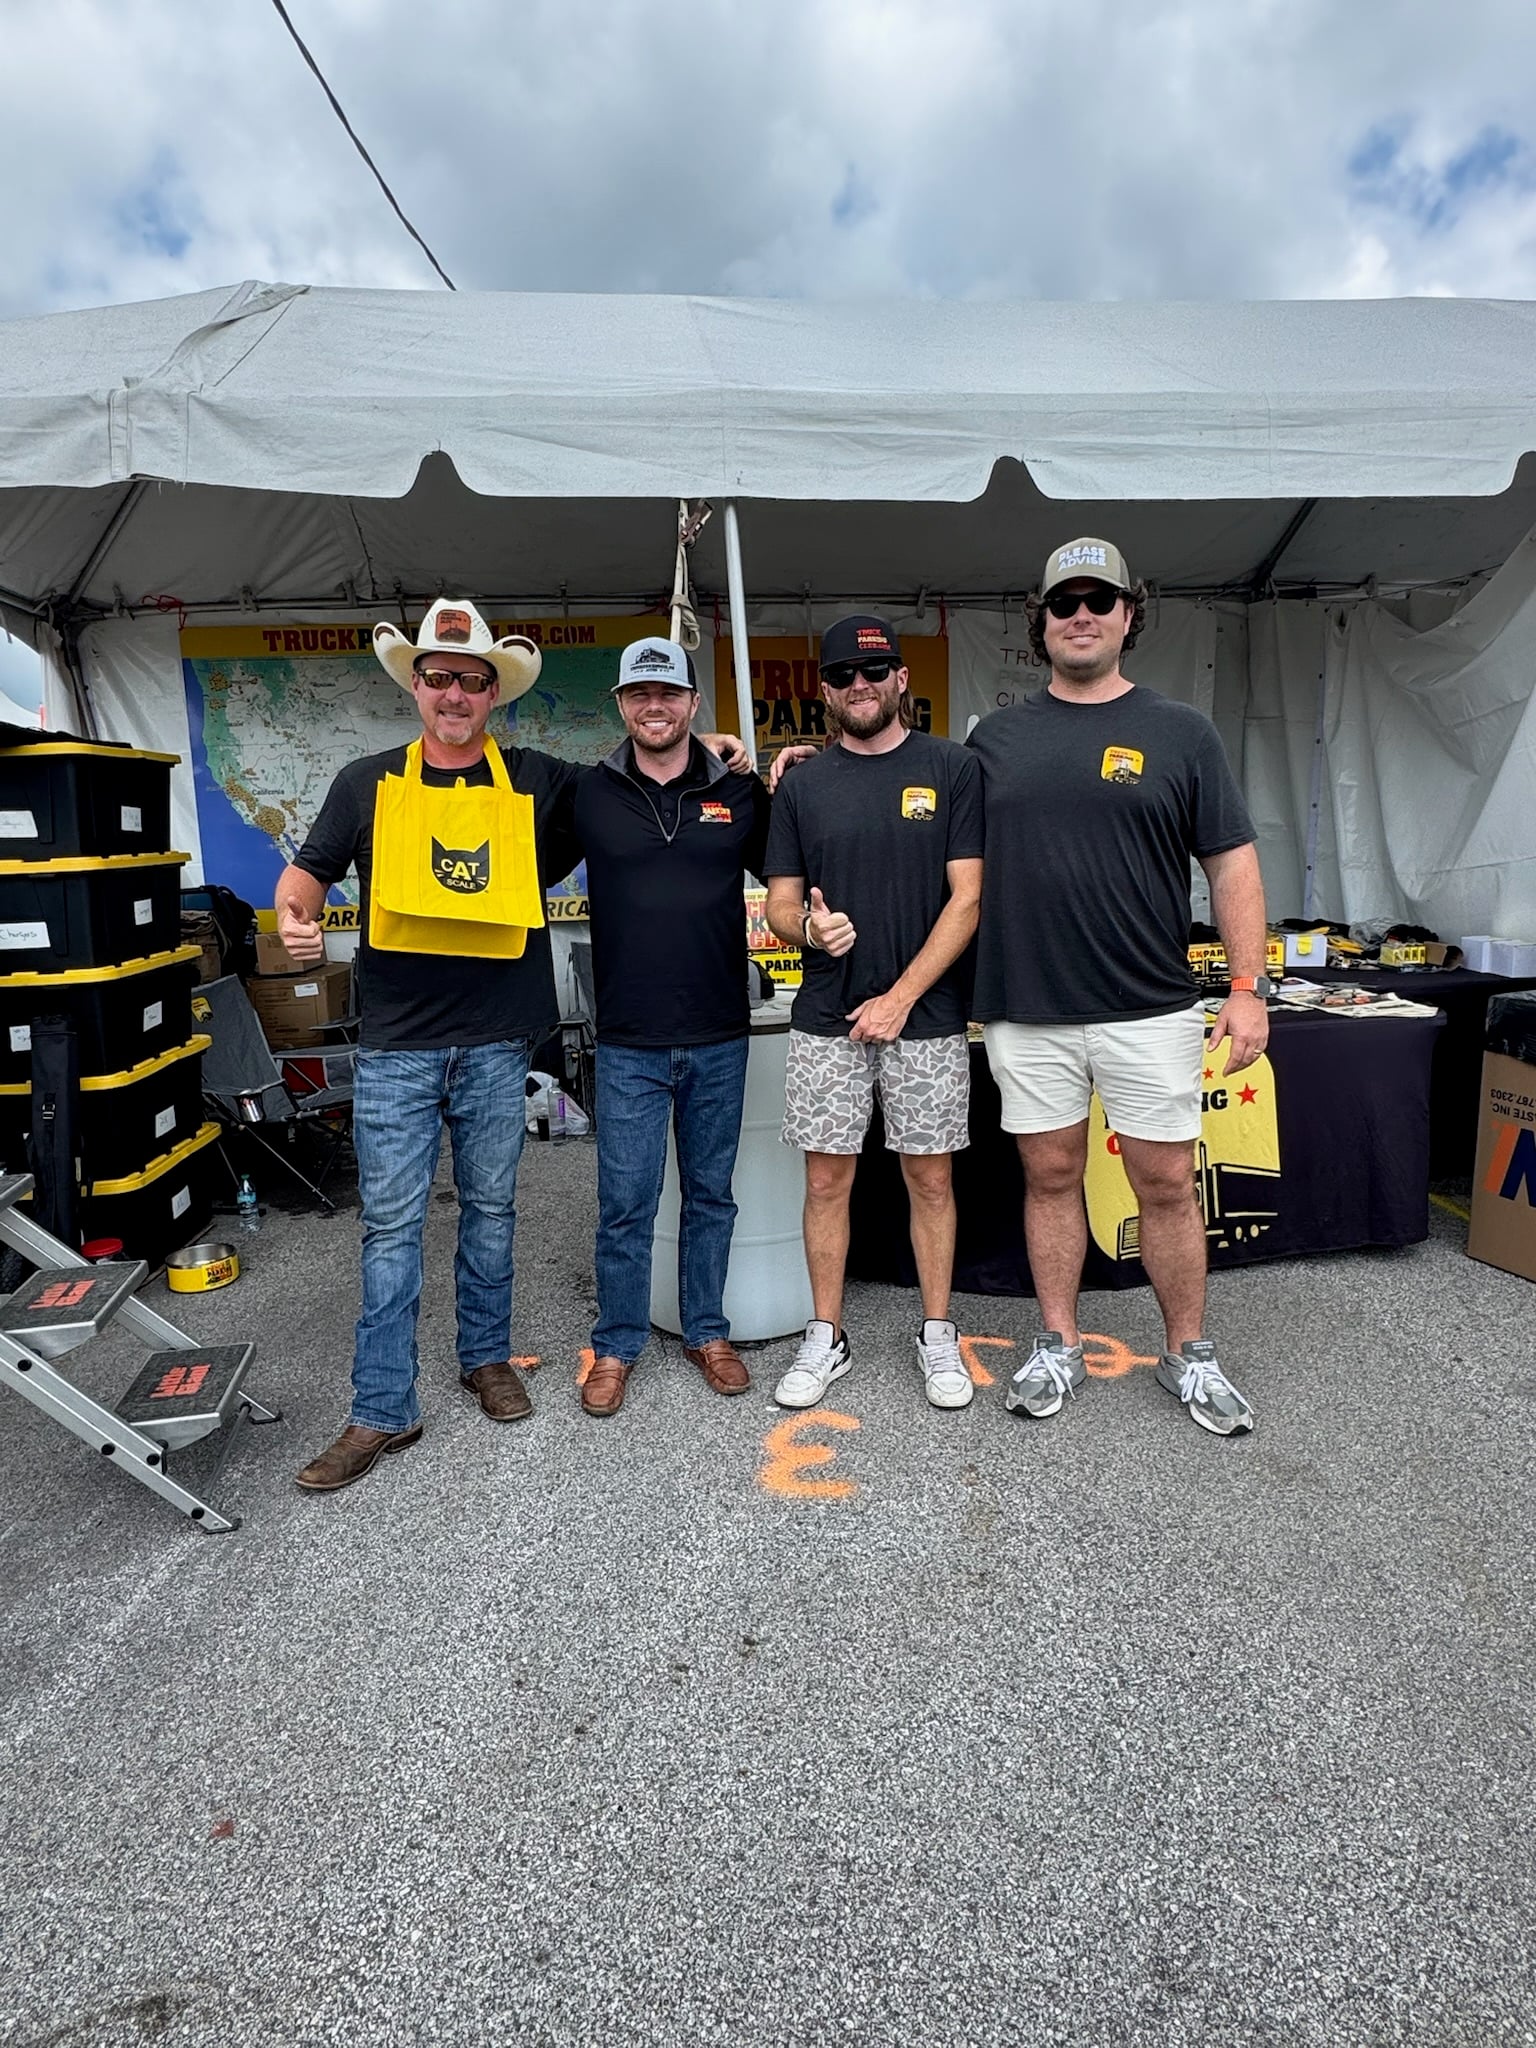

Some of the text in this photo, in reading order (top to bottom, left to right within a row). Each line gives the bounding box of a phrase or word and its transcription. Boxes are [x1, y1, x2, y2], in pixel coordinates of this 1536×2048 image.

[1059, 546, 1106, 563] PLEASE
[1058, 556, 1107, 572] ADVISE
[440, 858, 480, 881] CAT
[446, 878, 478, 891] SCALE
